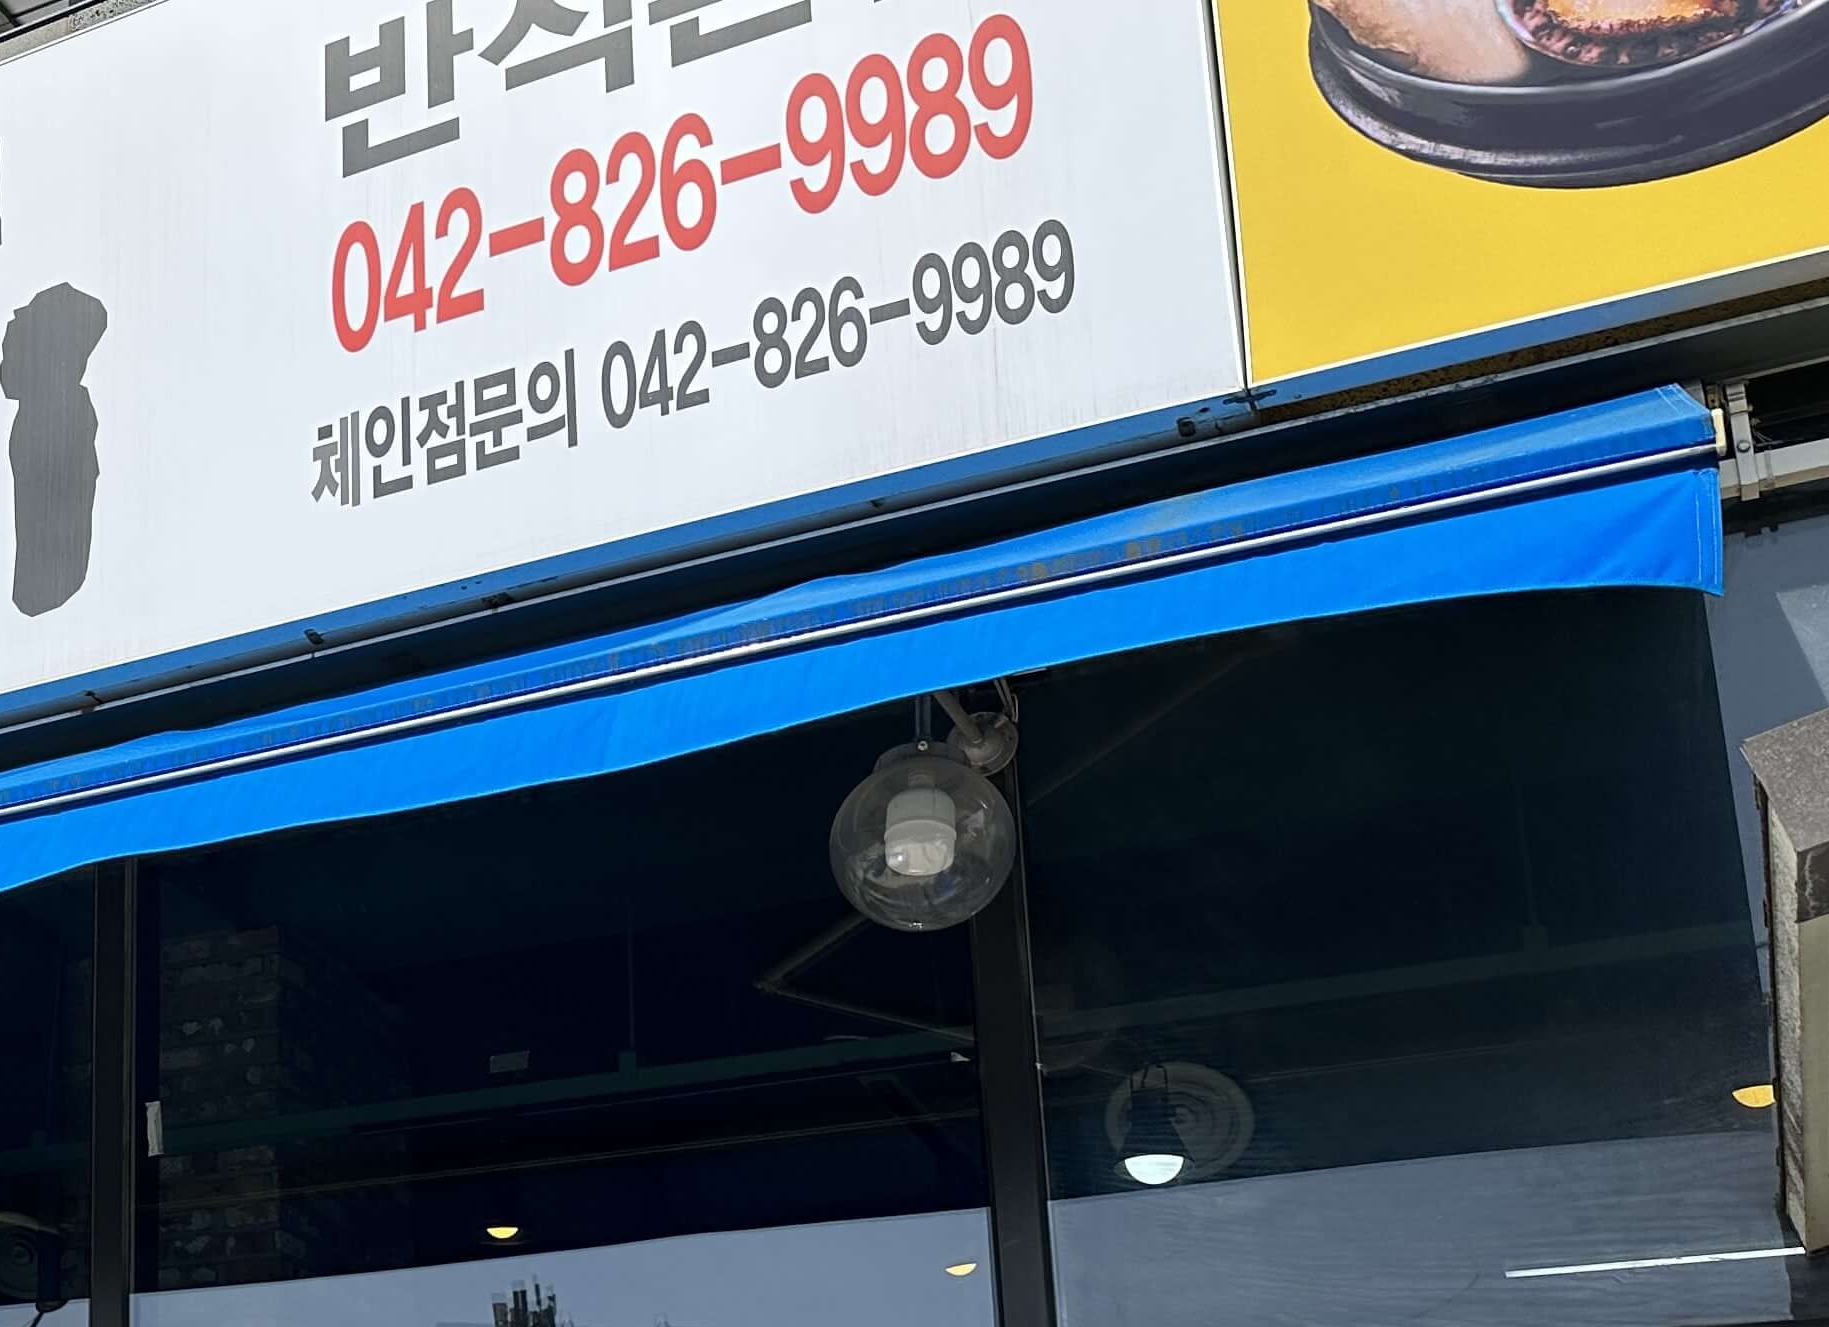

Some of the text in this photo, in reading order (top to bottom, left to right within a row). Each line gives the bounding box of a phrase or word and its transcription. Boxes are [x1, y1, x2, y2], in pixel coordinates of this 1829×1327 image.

[325, 0, 812, 178] 반석
[332, 14, 1034, 353] 042-826-9989
[312, 219, 1075, 507] 체인점문의 042-826-9989
